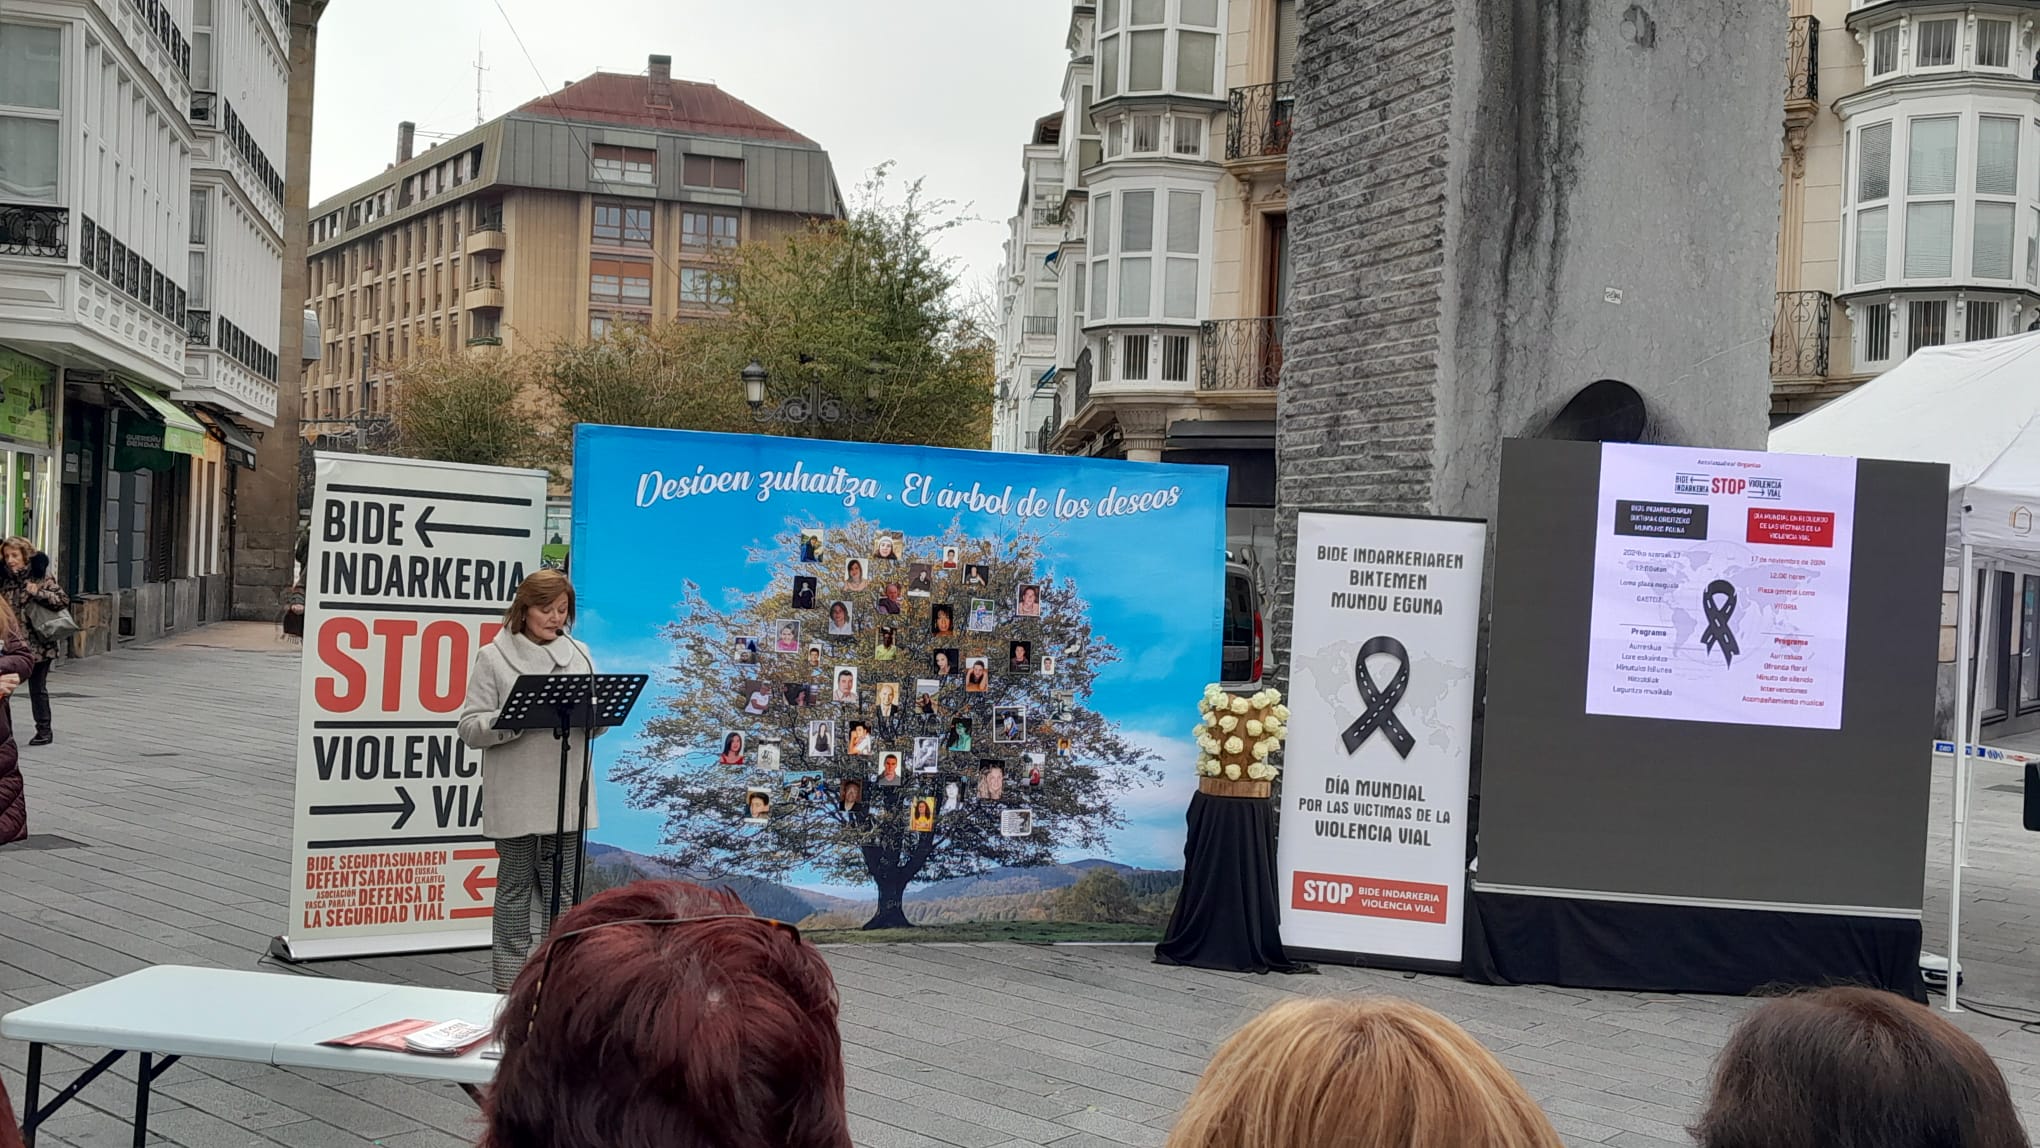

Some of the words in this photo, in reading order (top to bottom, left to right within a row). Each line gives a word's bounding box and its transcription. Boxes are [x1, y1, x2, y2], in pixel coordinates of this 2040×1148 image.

[635, 465, 755, 507] Desioen
[756, 461, 880, 507] zuhaitza
[901, 472, 934, 508] El
[937, 482, 1012, 515] árbol
[1016, 487, 1051, 518] de
[1054, 488, 1094, 519] los
[1096, 485, 1184, 517] deseos
[1674, 484, 1709, 492] INDARKERIA
[1676, 476, 1688, 484] BIDE
[1712, 478, 1746, 494] STOP
[1748, 480, 1782, 489] VIOLENCIA
[1767, 488, 1781, 498] VIAL
[323, 499, 404, 546] BIDE
[1318, 545, 1348, 562] BIDE
[1353, 548, 1464, 569] INDARKERIAREN
[320, 551, 525, 601] INDARKERIA
[1350, 570, 1427, 590] BIKTEMEN
[1331, 592, 1387, 612] MUNDU
[1393, 596, 1443, 615] EGUNA
[1631, 628, 1667, 637] Programa
[1774, 637, 1808, 646] Programa
[315, 617, 503, 713] STO
[1764, 662, 1790, 671] Ofrenda
[1760, 686, 1808, 694] Intervenciones
[313, 736, 483, 780] VIOLENC
[1325, 775, 1350, 795] DÍA
[1355, 780, 1426, 802] MUNDIAL
[1299, 798, 1322, 812] POR
[1327, 801, 1349, 814] LAS
[1354, 803, 1412, 820] VICTIMAS
[1416, 808, 1432, 822] DE
[1436, 810, 1450, 824] LA
[1315, 820, 1392, 842] VIOLENCIA
[1399, 828, 1432, 846] VIAL
[307, 856, 335, 871] BIDE
[339, 851, 447, 870] SEGURTASUNAREN
[415, 867, 438, 875] EUSKAL
[306, 868, 413, 889] DEFENTSARAKO
[415, 875, 445, 884] ELKARTEA
[359, 886, 422, 906] DEFENSA
[428, 884, 445, 902] DE
[1304, 880, 1354, 904] STOP
[1358, 887, 1380, 897] BIDE
[1382, 888, 1440, 902] INDARKERIA
[305, 900, 326, 909] VASCA
[328, 899, 345, 908] PARA
[348, 898, 356, 906] LA
[1361, 898, 1412, 912] VIOLENCIA
[1414, 904, 1436, 914] VIAL
[304, 910, 322, 928] LA
[326, 905, 408, 927] SEGURIDAD
[414, 903, 444, 921] VIAL
